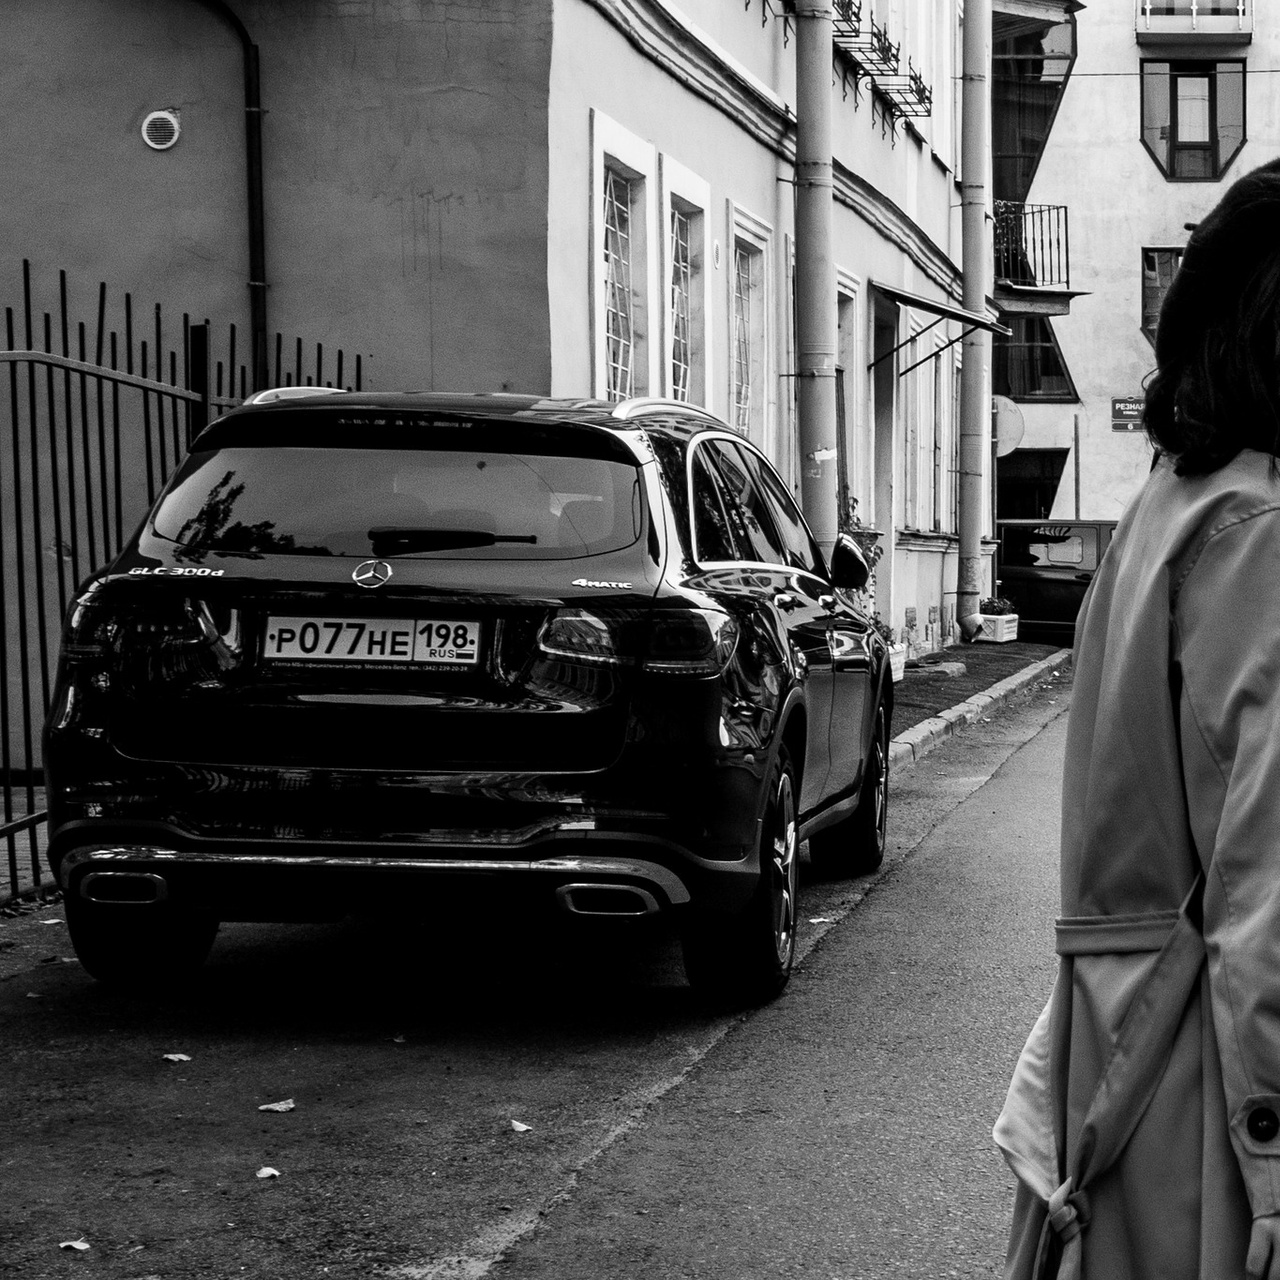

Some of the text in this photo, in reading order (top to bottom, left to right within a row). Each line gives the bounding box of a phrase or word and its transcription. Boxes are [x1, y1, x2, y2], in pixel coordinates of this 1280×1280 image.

[128, 567, 225, 577] GLC 300d
[276, 621, 469, 656] Р077НЕ 198
[429, 648, 455, 659] RUS
